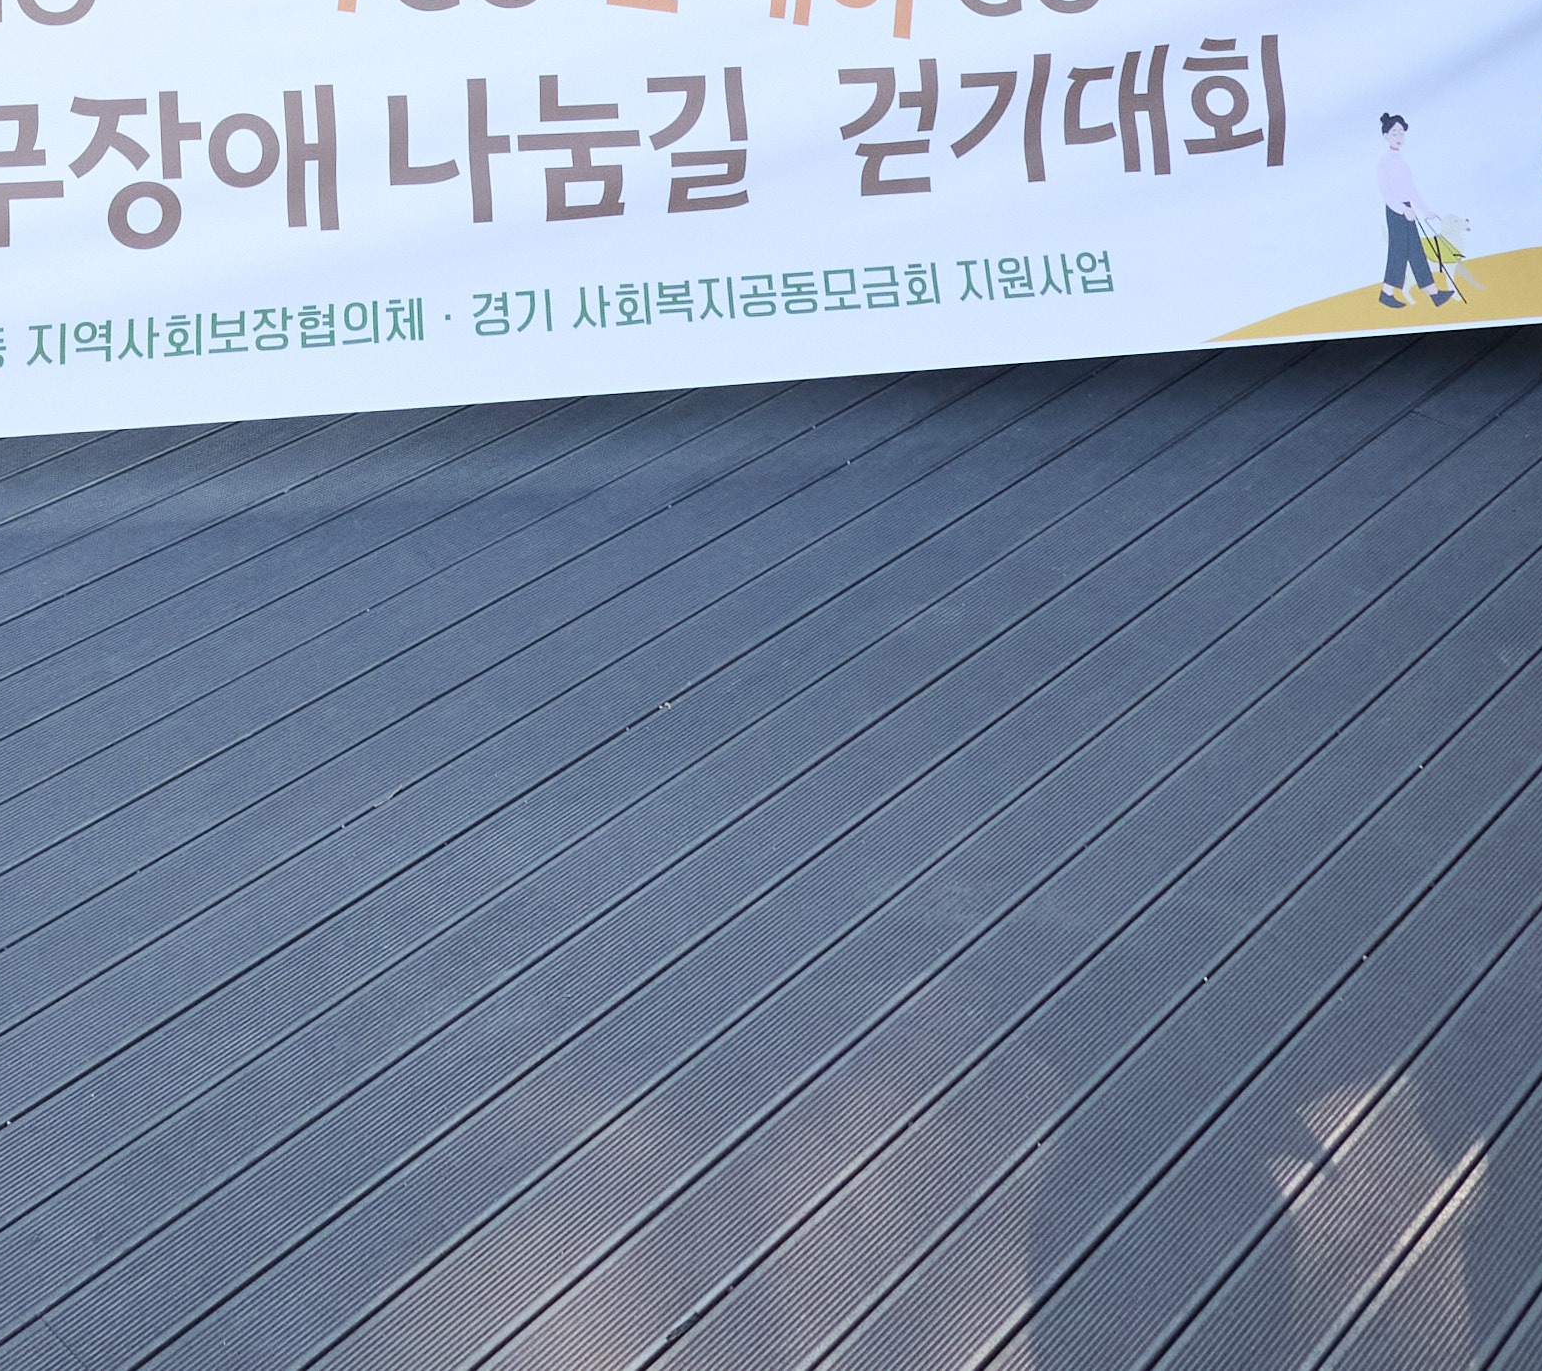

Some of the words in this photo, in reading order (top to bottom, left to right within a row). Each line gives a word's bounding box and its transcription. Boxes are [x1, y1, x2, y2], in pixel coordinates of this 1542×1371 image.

[386, 66, 751, 224] 나눔길
[837, 33, 1287, 198] 걷기대회
[26, 295, 426, 369] 지역사회보장협의체
[471, 287, 554, 337] 경기
[572, 261, 942, 332] 사회복지공동모금회
[959, 250, 1116, 304] 지원사업
